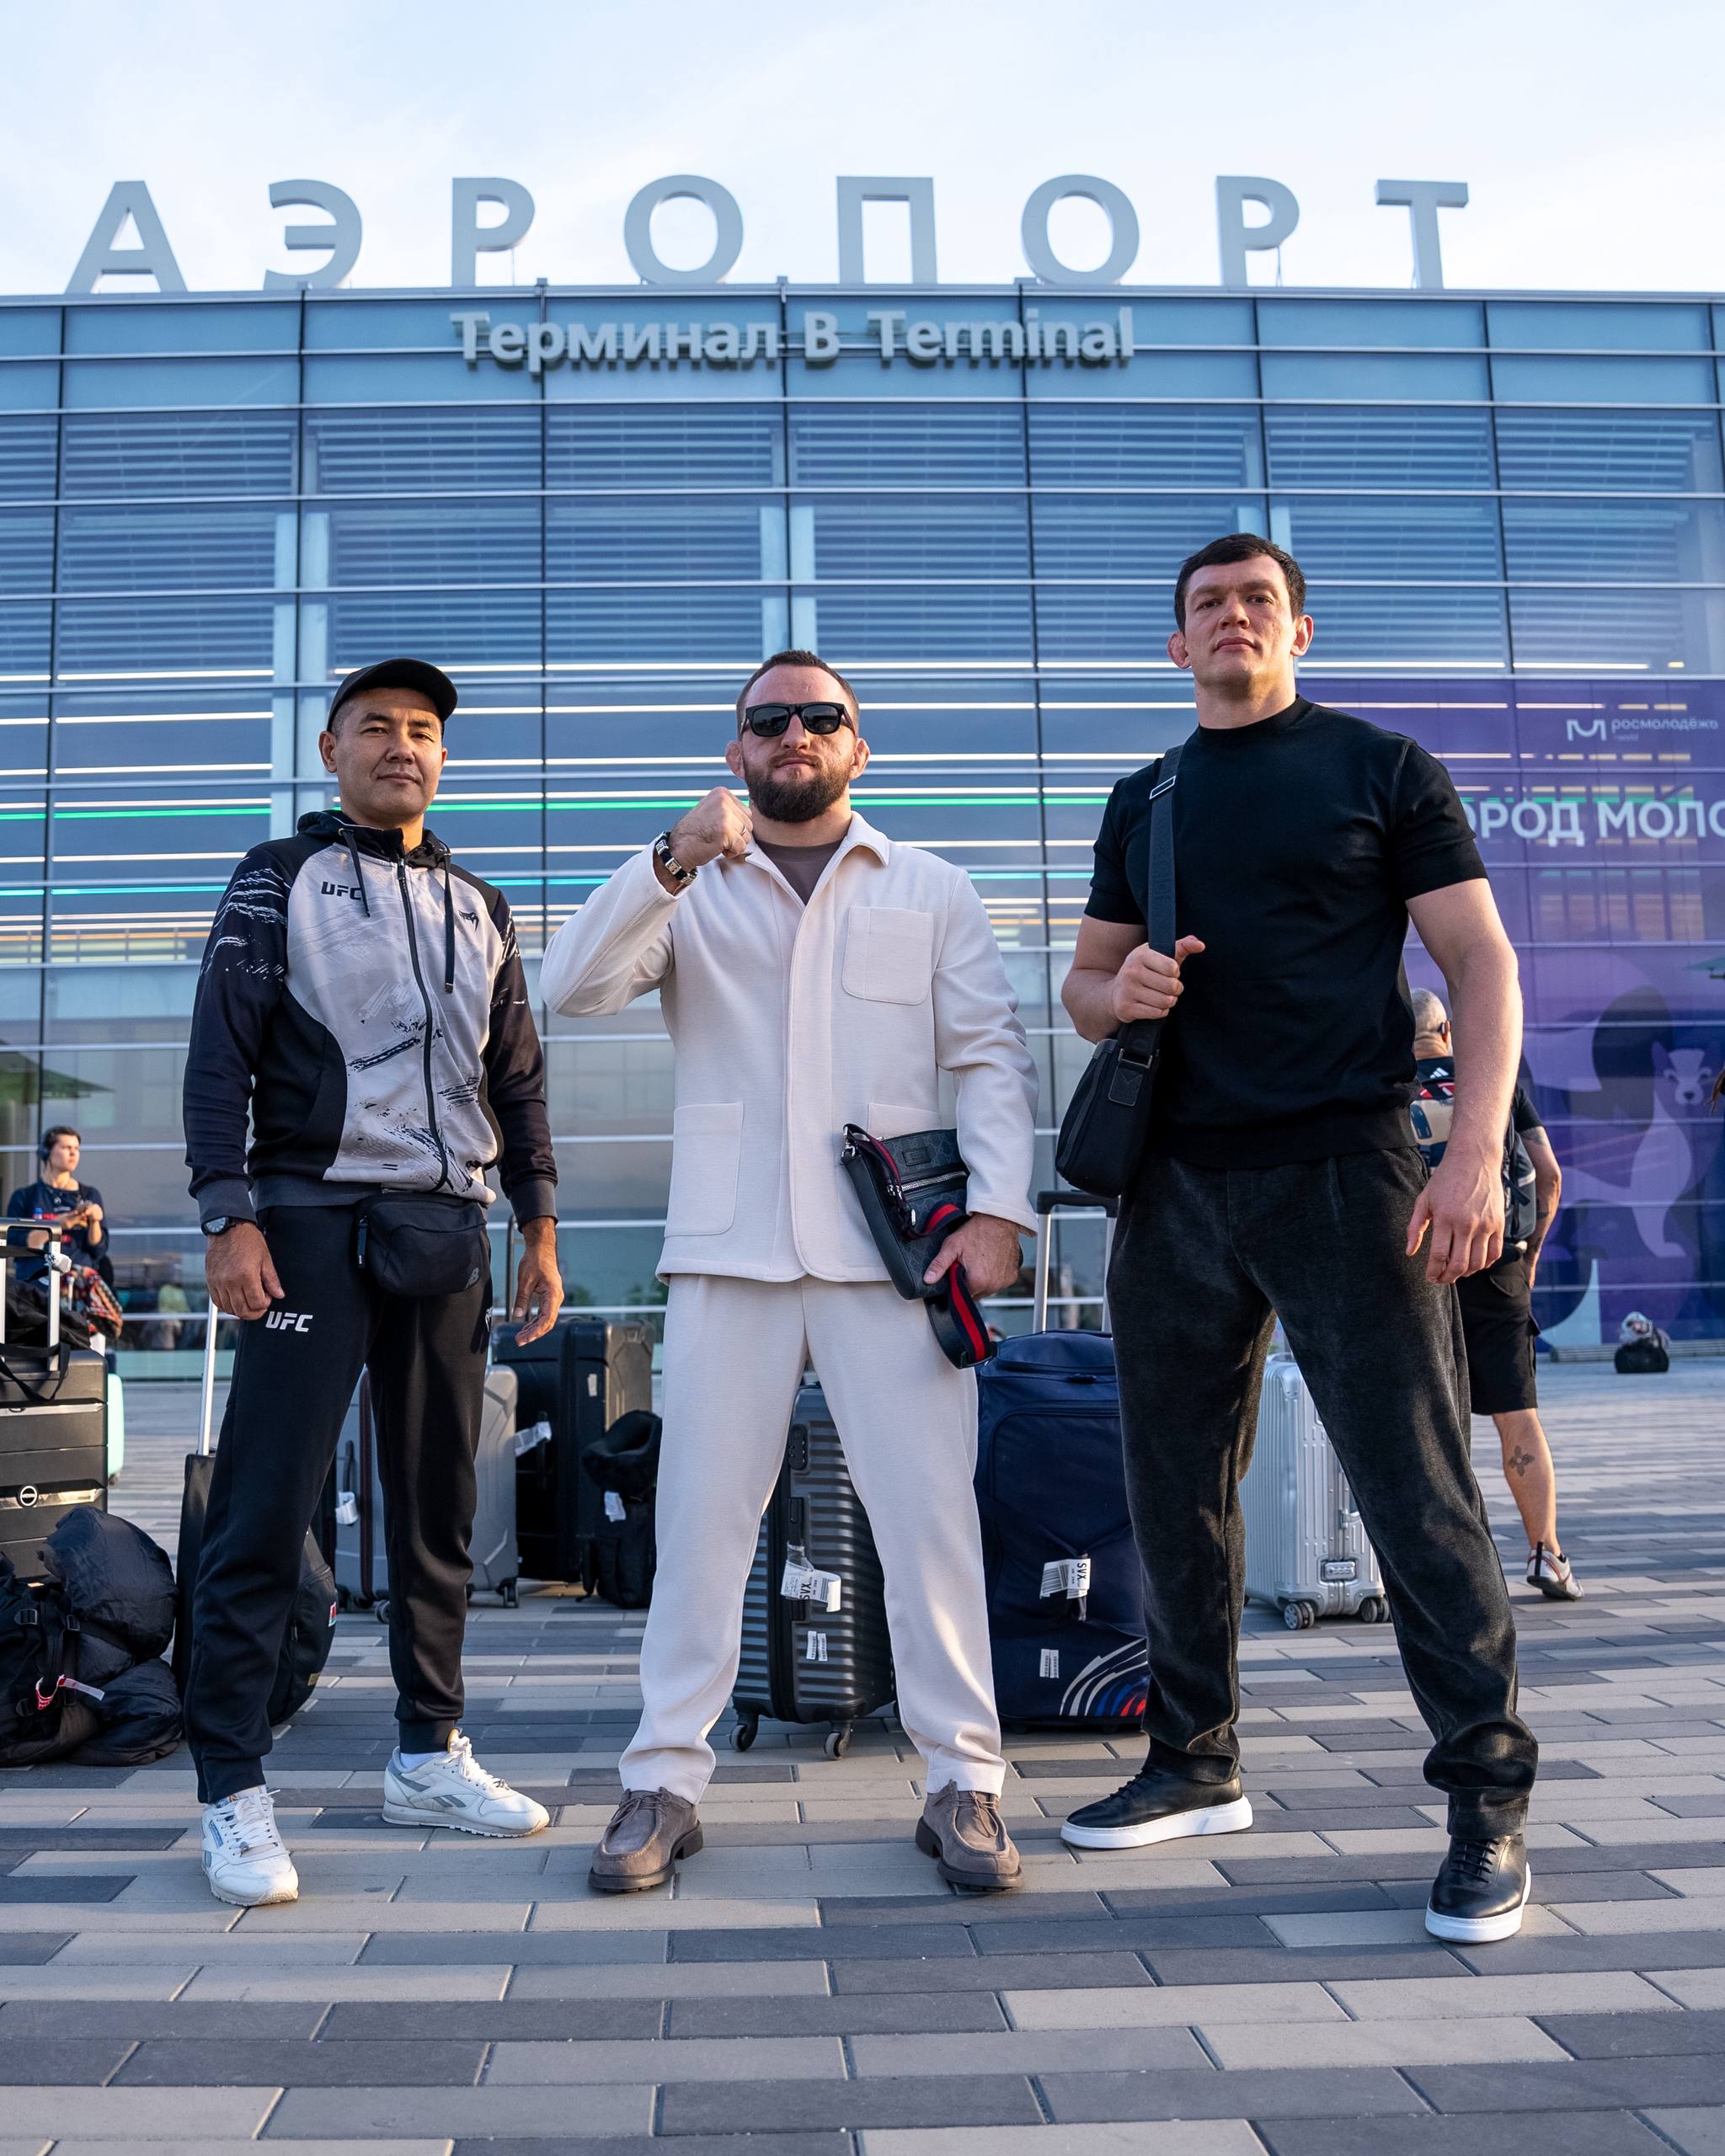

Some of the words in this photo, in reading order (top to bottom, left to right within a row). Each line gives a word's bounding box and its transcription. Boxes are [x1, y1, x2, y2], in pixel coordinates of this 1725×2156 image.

[64, 174, 1469, 294] АЭРОПОРТ
[449, 312, 777, 372] Терминал
[867, 307, 1134, 360] Terminal
[321, 881, 361, 900] UFC
[265, 1310, 313, 1332] UFC
[1077, 1562, 1087, 1580] SVX
